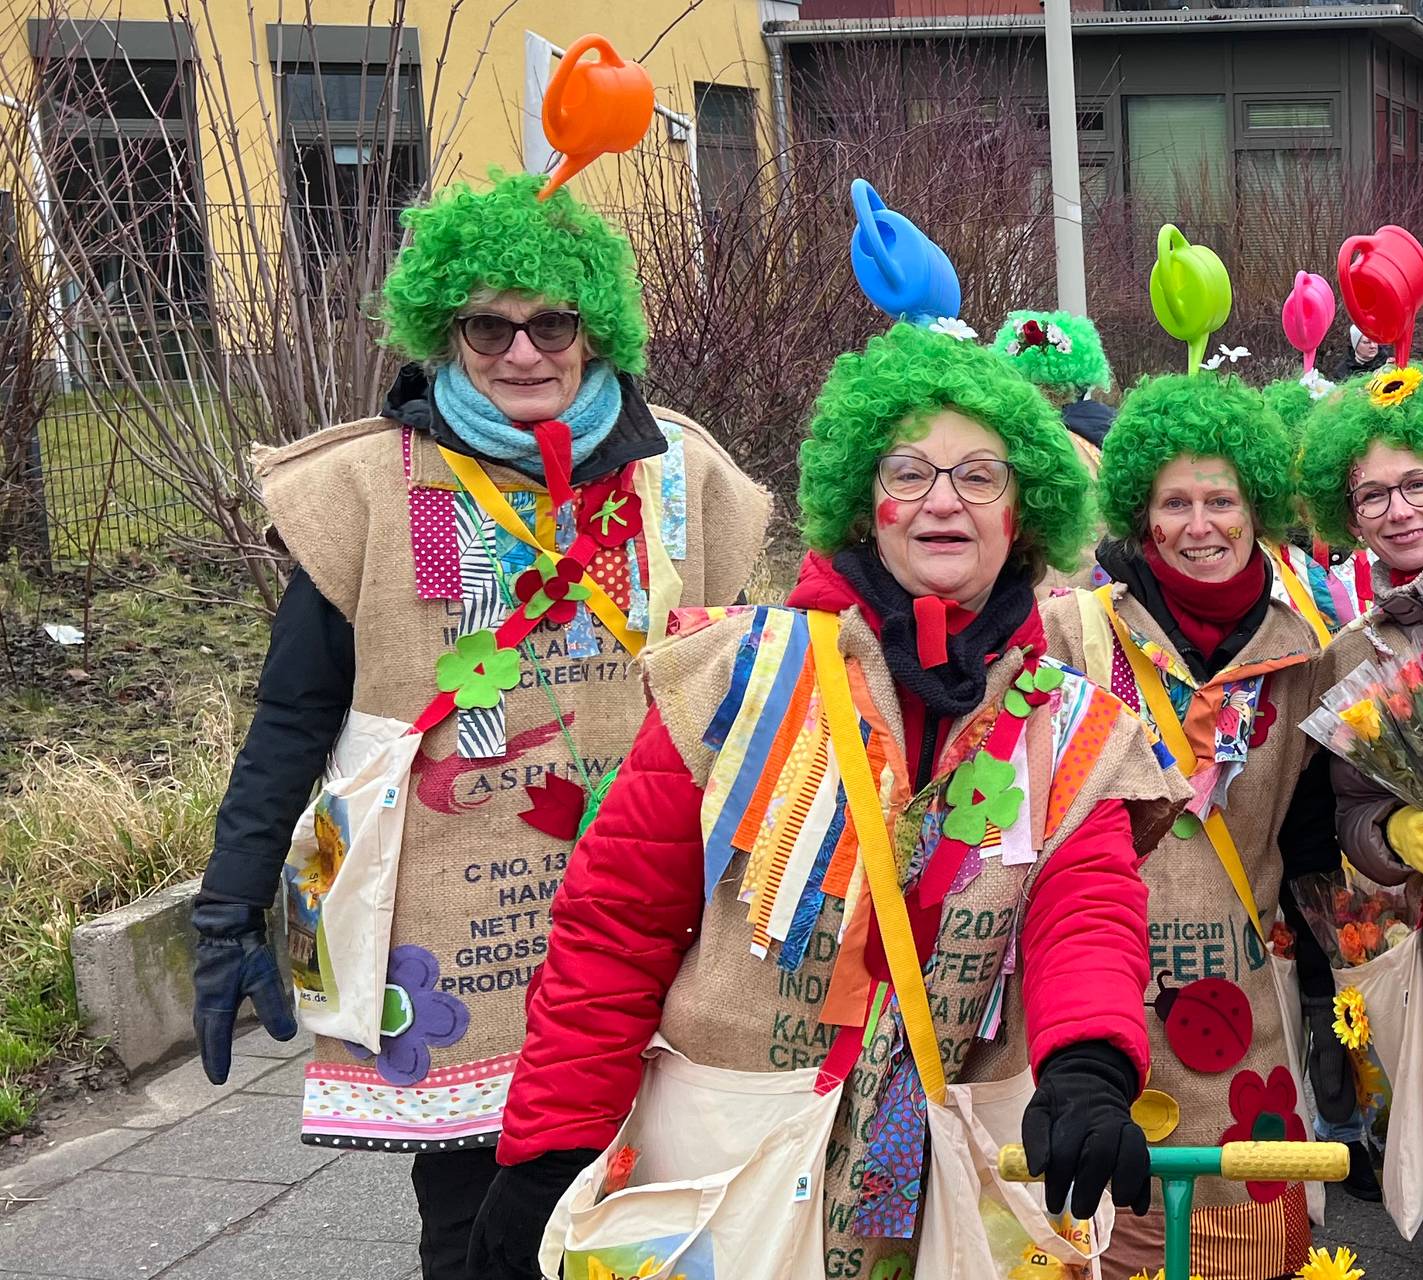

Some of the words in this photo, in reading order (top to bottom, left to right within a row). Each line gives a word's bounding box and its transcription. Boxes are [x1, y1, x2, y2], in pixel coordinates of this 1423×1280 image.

[464, 864, 482, 883] C
[491, 858, 532, 880] NO.
[499, 879, 563, 907] HAM
[470, 910, 540, 940] NETT
[456, 934, 548, 968] GROSS
[441, 965, 539, 995] PRODU
[777, 970, 830, 1004] IND
